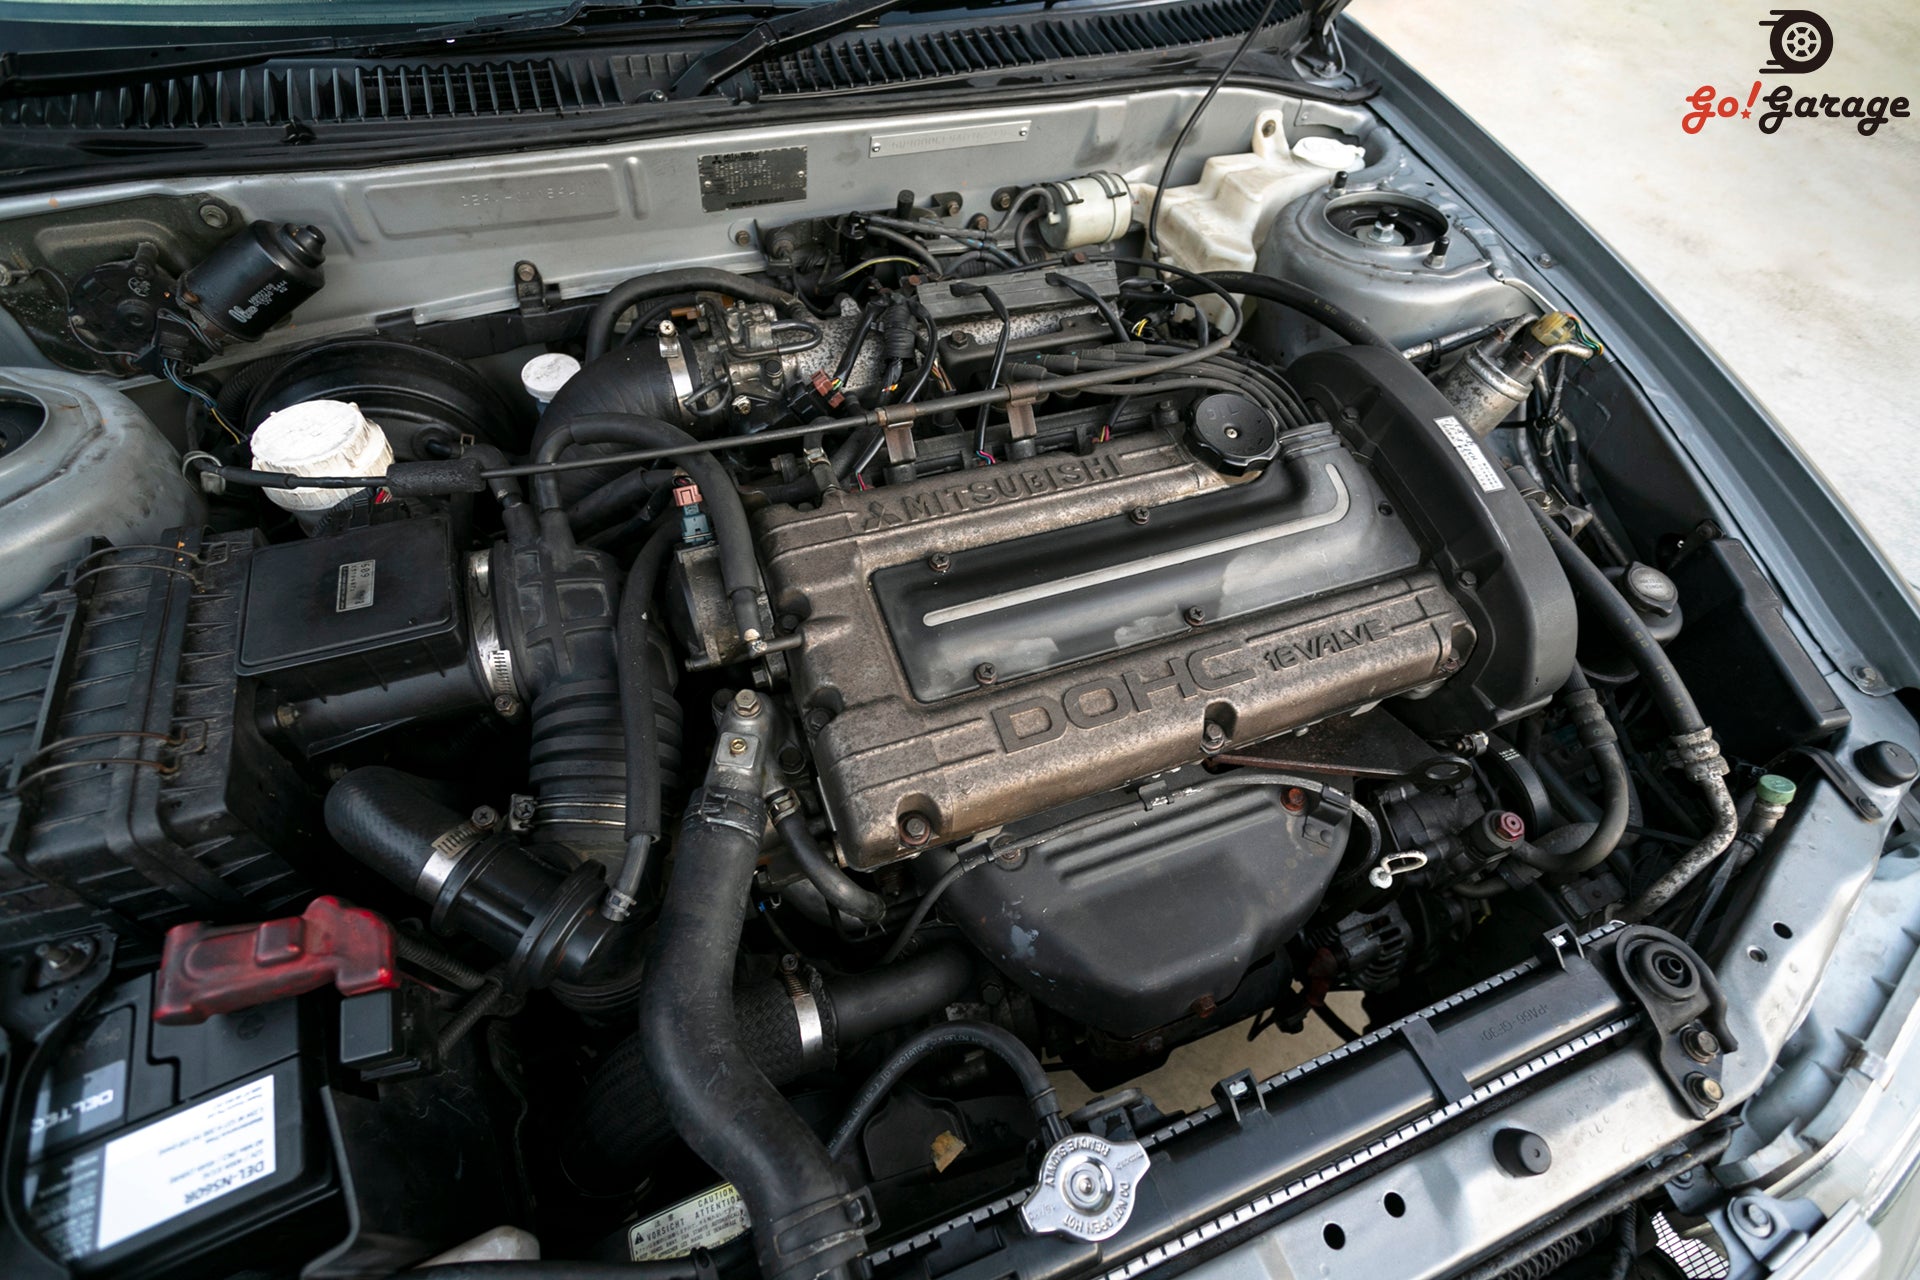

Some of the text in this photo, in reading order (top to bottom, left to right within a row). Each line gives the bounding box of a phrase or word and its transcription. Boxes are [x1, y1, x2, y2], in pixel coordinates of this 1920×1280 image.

[1206, 402, 1240, 420] OIL
[903, 454, 1124, 522] MITSUBISHI
[991, 638, 1257, 754] DOHC
[1044, 1137, 1111, 1189] REMOVE SLOWLY
[698, 1187, 734, 1208] CAUTION
[1063, 1182, 1131, 1235] DO NOT OPEN HOT
[646, 1217, 685, 1242] VORSICHT
